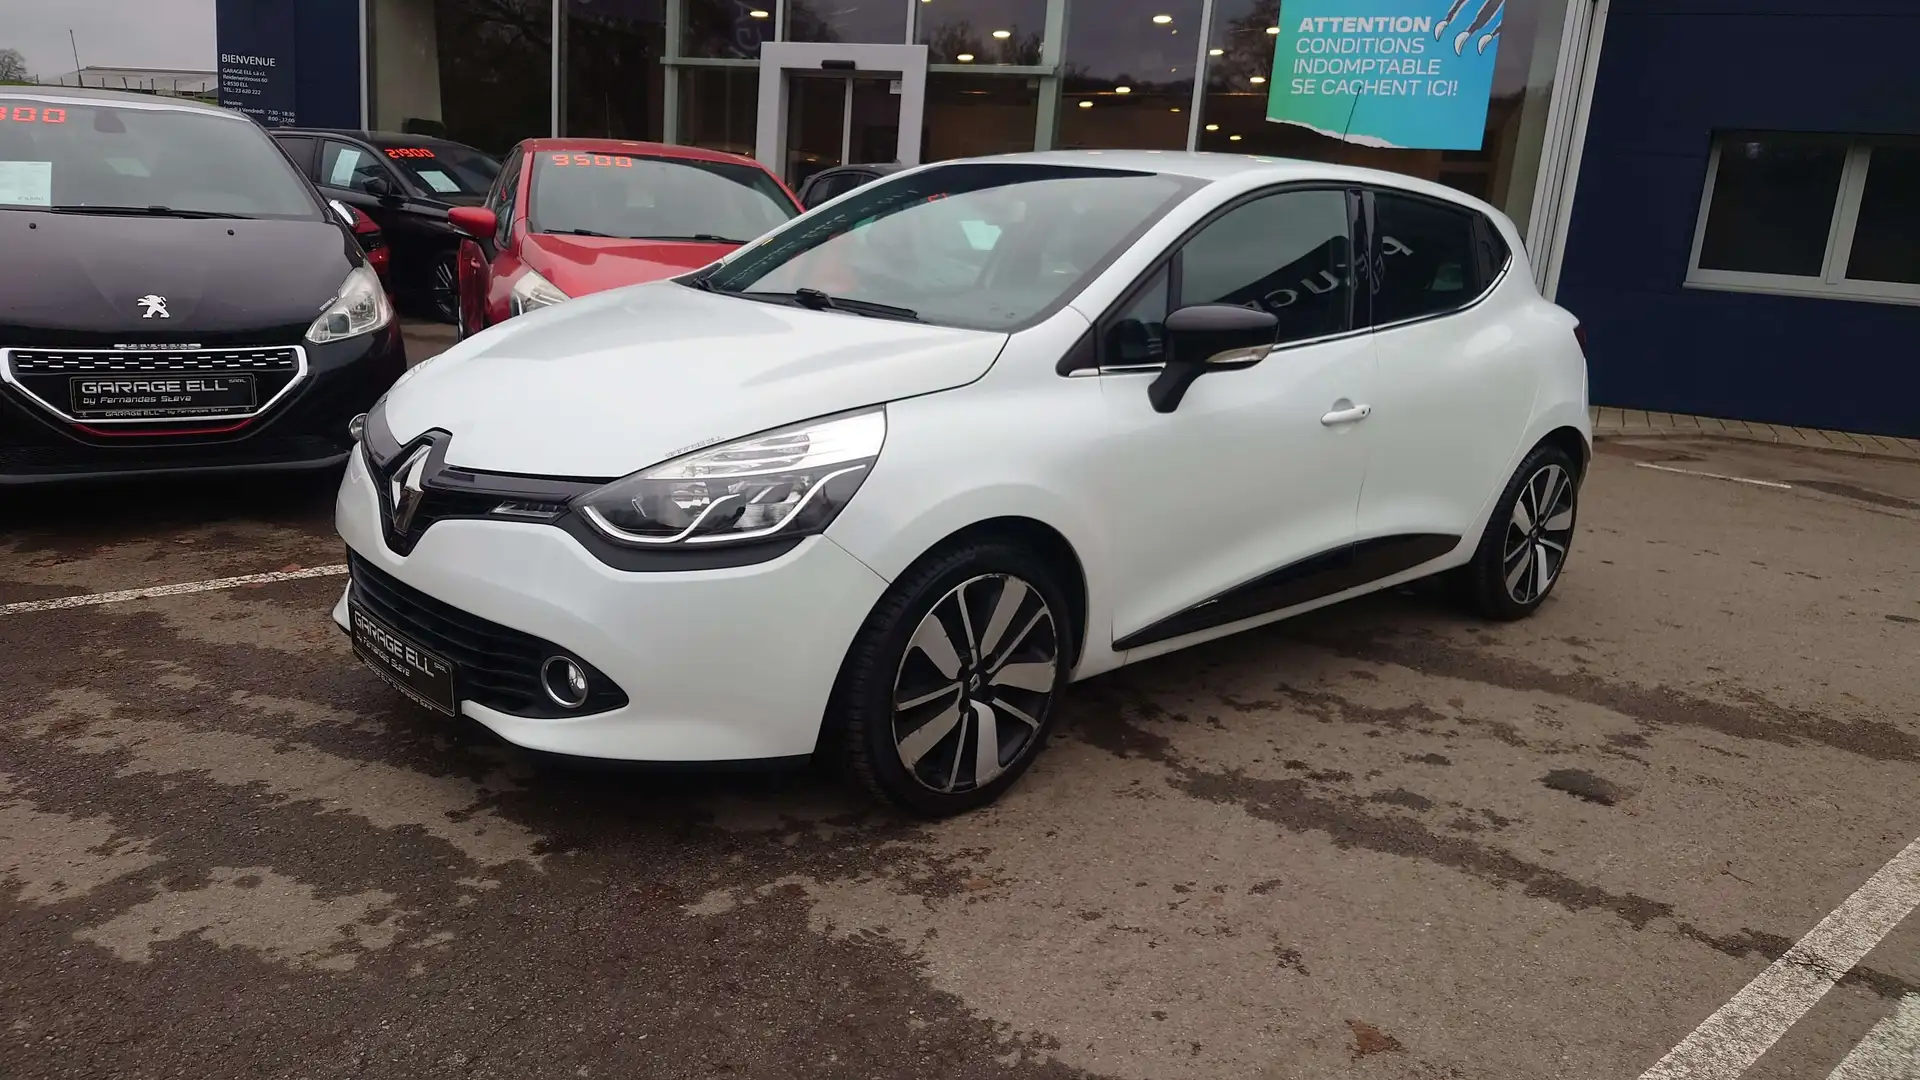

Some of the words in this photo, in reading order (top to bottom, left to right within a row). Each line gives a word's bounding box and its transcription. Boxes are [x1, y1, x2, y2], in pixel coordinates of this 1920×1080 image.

[1298, 16, 1432, 33] ATTENTION
[1296, 37, 1425, 54] CONDITIONS
[221, 53, 276, 67] BIENVENUE
[1293, 58, 1442, 75] INDOMPTABLE
[1290, 79, 1317, 95] SE
[1321, 79, 1422, 96] CACHENT
[1427, 80, 1459, 96] ICI!
[384, 148, 435, 159] 21900
[552, 155, 633, 168] 9500
[81, 381, 181, 394] GARAGE
[185, 380, 229, 392] ELL
[83, 397, 96, 405] by
[100, 395, 157, 404] Fernandes
[160, 395, 192, 403] Steve
[354, 610, 403, 660] GARAGE
[405, 646, 435, 678] ELL
[391, 658, 411, 677] Steve
